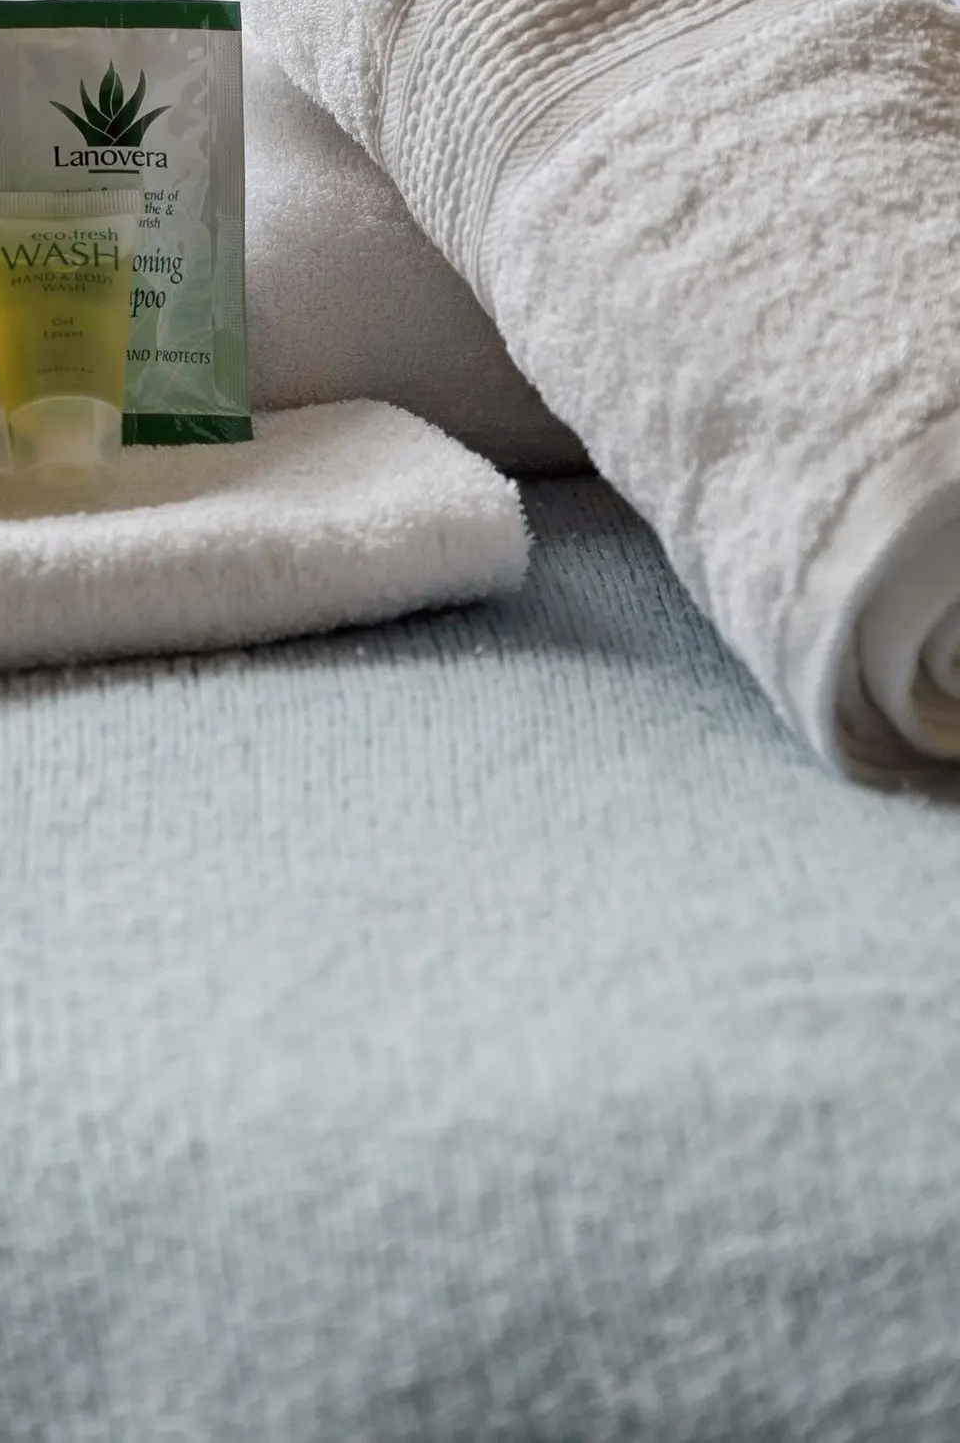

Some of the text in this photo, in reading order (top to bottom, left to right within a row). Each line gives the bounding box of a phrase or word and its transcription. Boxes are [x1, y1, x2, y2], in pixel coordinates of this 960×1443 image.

[53, 146, 168, 169] Lanovera
[167, 189, 181, 202] of
[165, 205, 174, 215] &
[31, 227, 119, 243] eco.fresh
[1, 242, 120, 271] WASH
[132, 247, 184, 285] oning
[10, 272, 114, 287] HAND & BODY
[42, 283, 86, 294] WASH
[155, 349, 211, 365] PROTECTS
